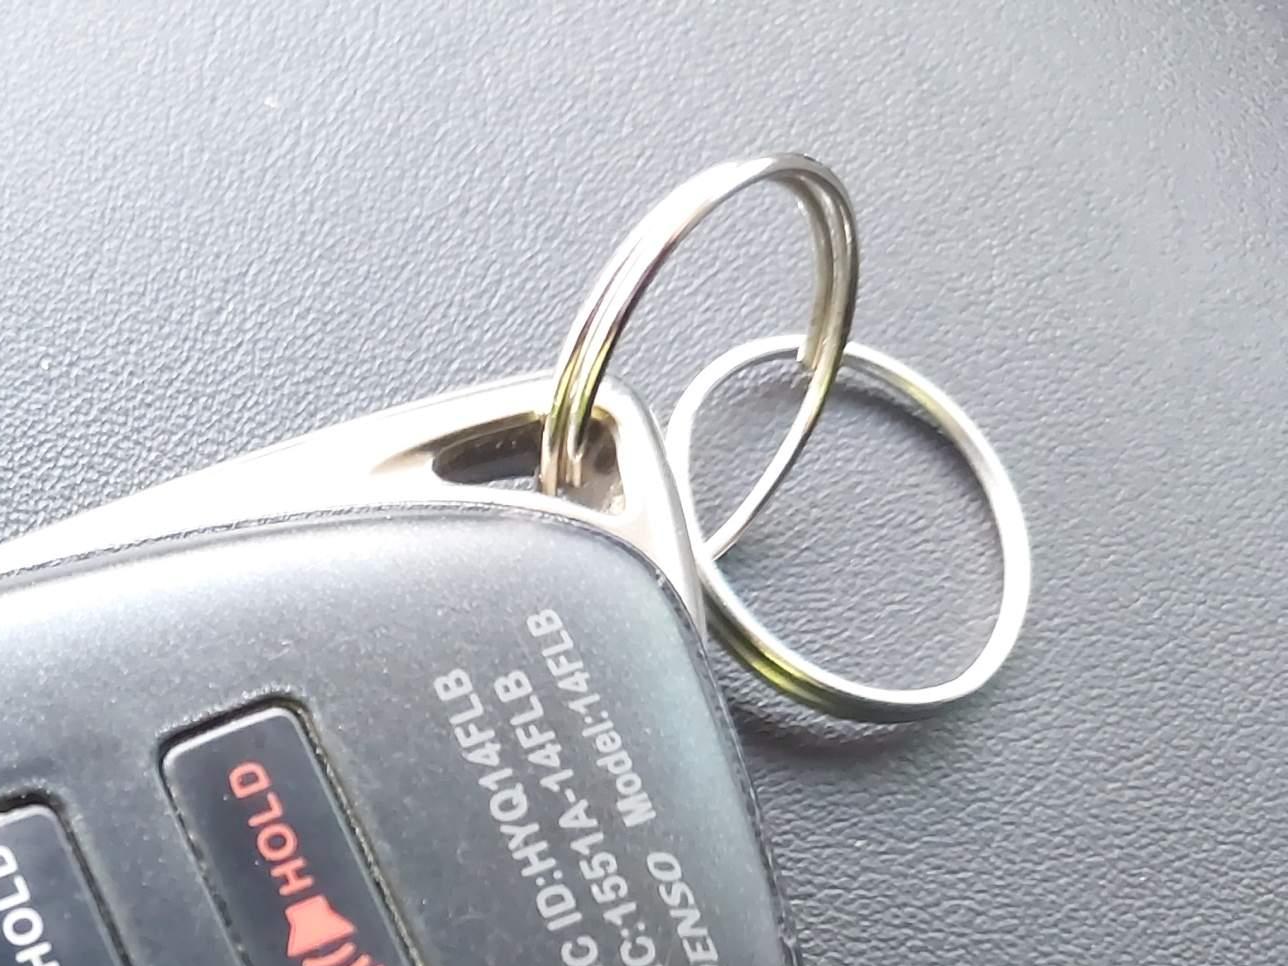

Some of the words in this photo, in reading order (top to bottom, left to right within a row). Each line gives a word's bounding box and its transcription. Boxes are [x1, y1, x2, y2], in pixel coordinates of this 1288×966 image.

[433, 667, 583, 931] ID:HYQ14FLB
[526, 608, 656, 828] Model:14FLB
[228, 761, 315, 896] HOLD
